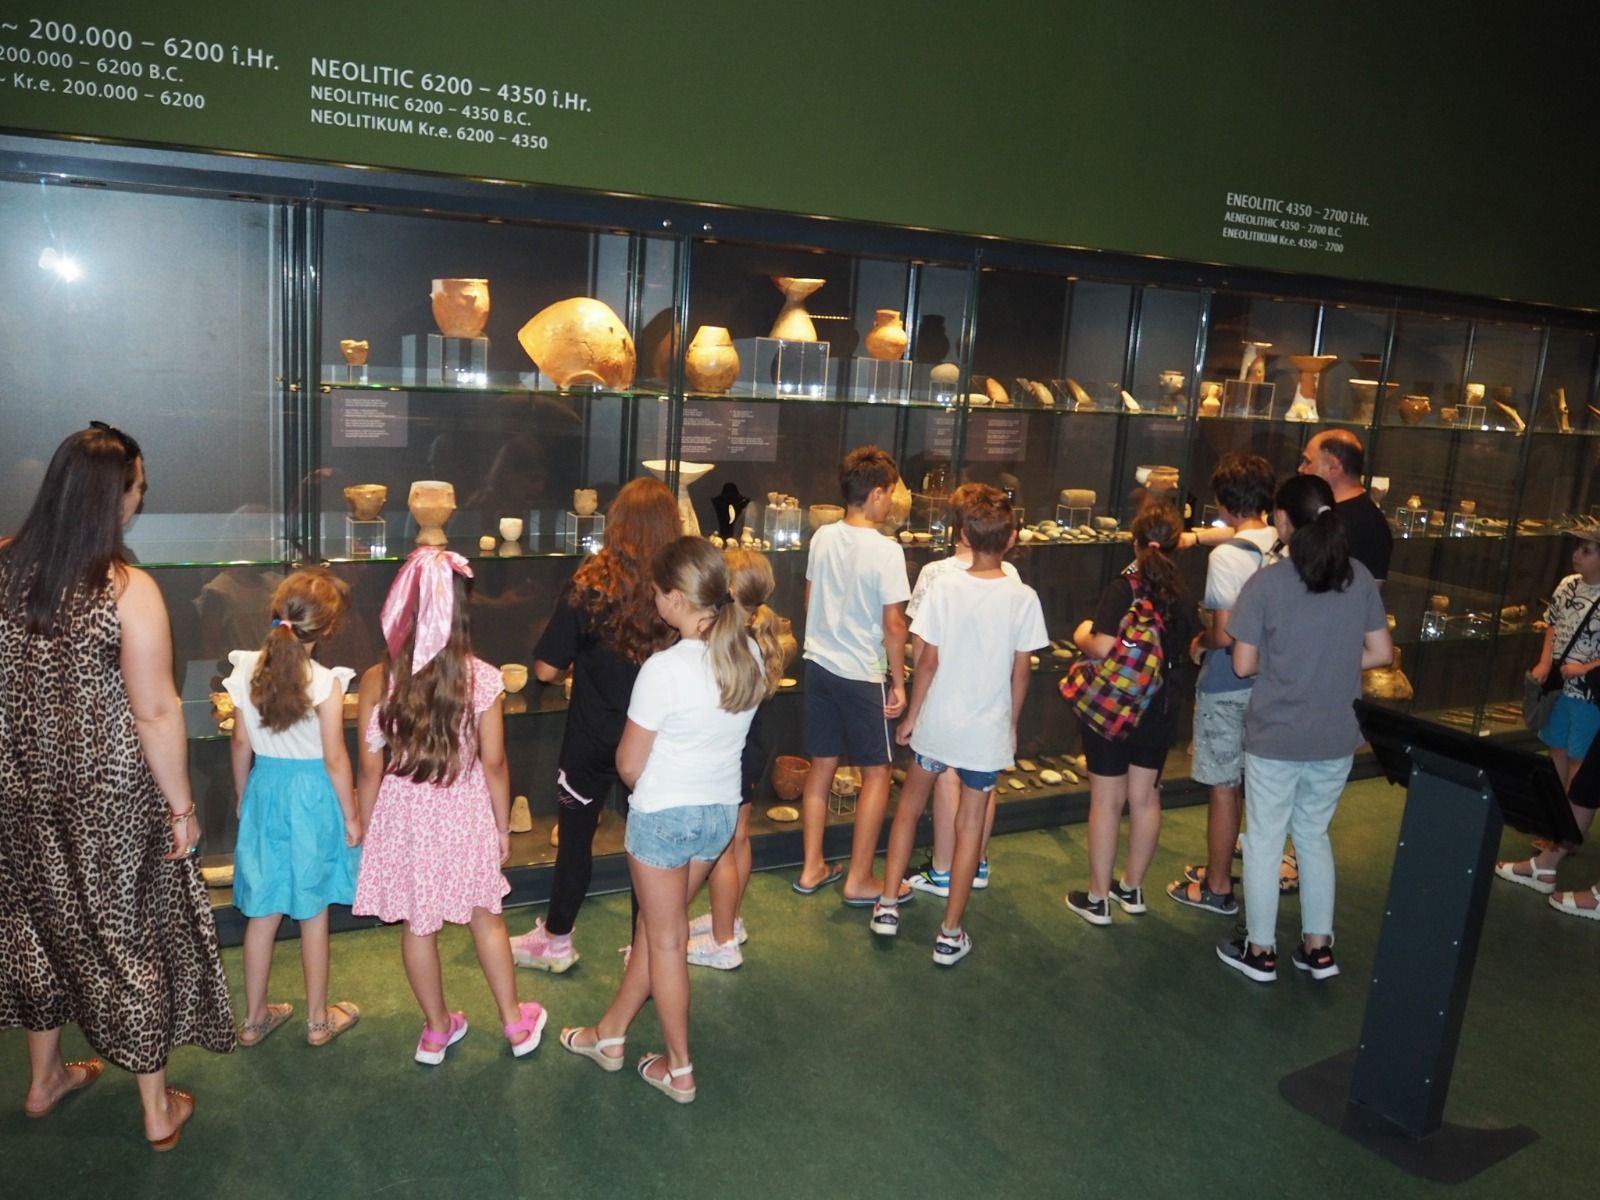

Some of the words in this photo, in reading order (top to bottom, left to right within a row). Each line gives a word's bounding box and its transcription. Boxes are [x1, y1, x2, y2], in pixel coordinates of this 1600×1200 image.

[29, 18, 133, 51] 200.000
[163, 37, 224, 63] 6200
[231, 44, 279, 71] î.Hr.
[96, 57, 143, 76] 6200
[149, 63, 184, 83] B.C.
[311, 56, 414, 90] NEOLITIC
[420, 73, 473, 96] 6200
[496, 83, 547, 106] 4350
[552, 89, 592, 113] î.Hr.
[13, 72, 56, 93] Kr.e.
[62, 78, 138, 102] 200.000
[160, 90, 206, 110] 6200
[310, 85, 400, 111] NEOLITHIC
[404, 97, 444, 115] 6200
[461, 104, 500, 122] 4350
[503, 109, 532, 127] B.C.
[310, 108, 413, 135] NEOLITIKUM
[418, 121, 452, 139] Kr.e.
[456, 126, 495, 144] 6200
[511, 133, 548, 150] 4350
[1223, 211, 1279, 229] AENEOLITHIC
[1279, 219, 1301, 232] 4350
[1307, 223, 1327, 236] 2700
[1327, 226, 1343, 238] B.C.
[1226, 191, 1285, 214] ENEOLITIC
[1285, 202, 1313, 218] 4350
[1322, 207, 1349, 224] 2700
[1222, 226, 1279, 244] ENEOLITIKUM
[1278, 235, 1297, 247] Kr.e.
[1297, 237, 1318, 250] 4350
[1324, 241, 1345, 253] 2700
